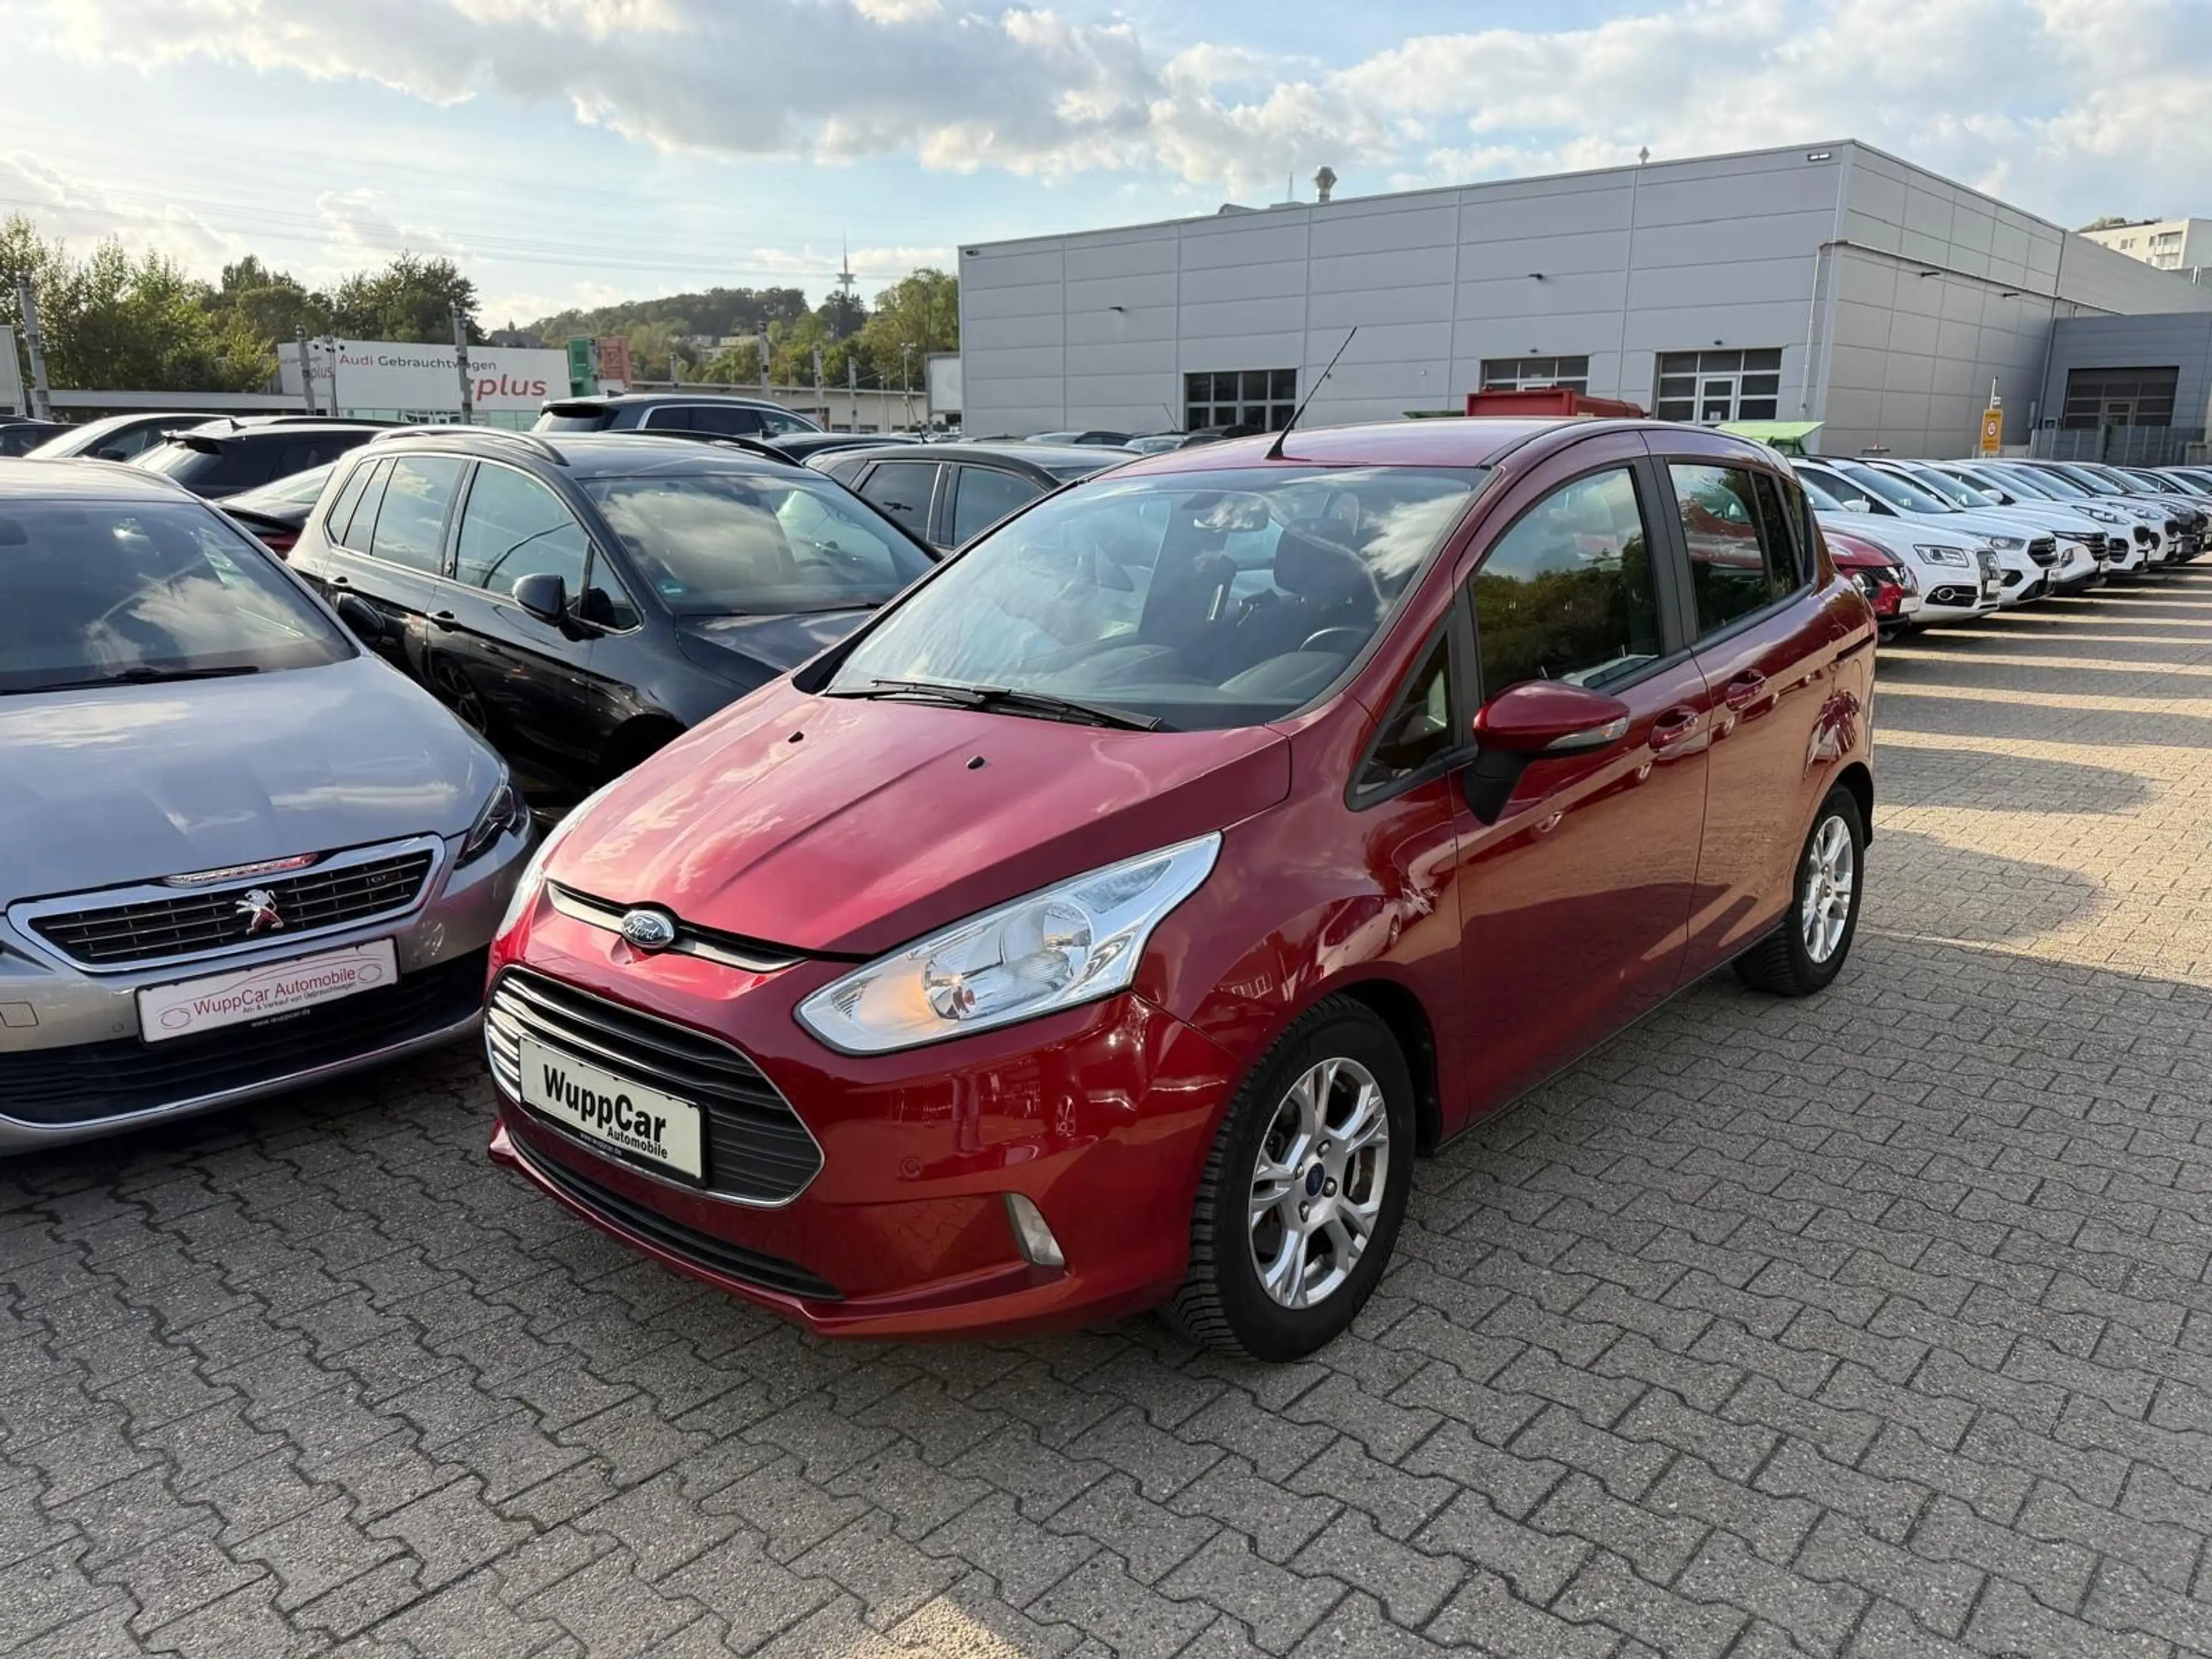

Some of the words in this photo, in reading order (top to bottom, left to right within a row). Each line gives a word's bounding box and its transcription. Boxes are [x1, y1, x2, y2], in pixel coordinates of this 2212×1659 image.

[340, 355, 373, 366] Audi
[624, 916, 659, 940] Ford
[194, 989, 270, 1016] WuppCar
[275, 968, 356, 998] Automobile
[543, 1063, 666, 1142] WuppCar
[607, 1126, 668, 1159] Automobile
